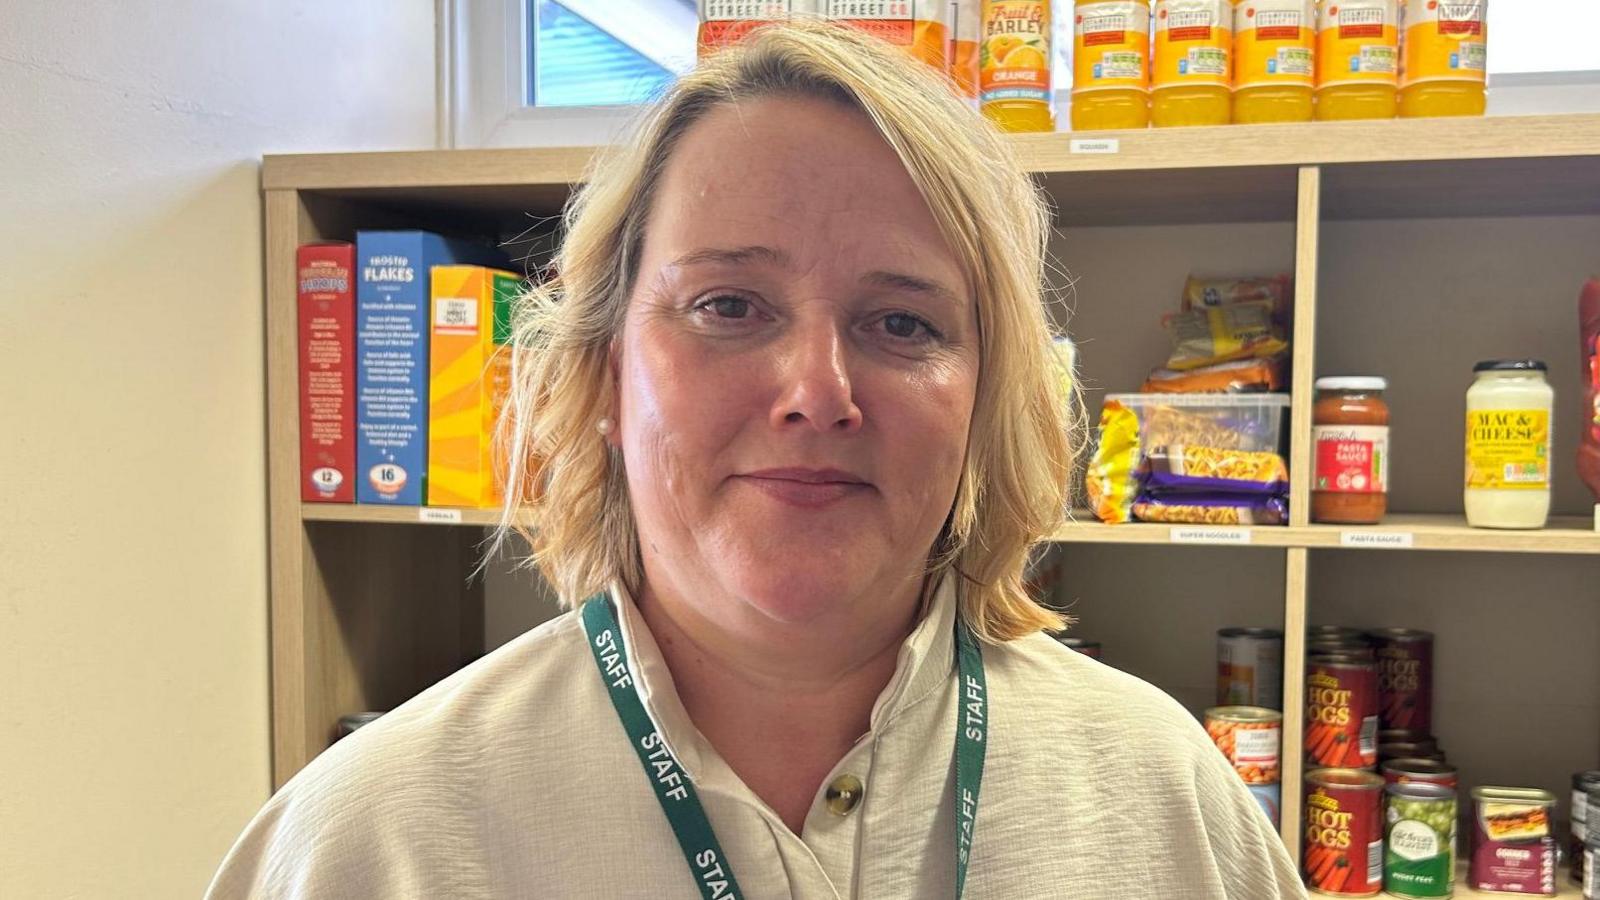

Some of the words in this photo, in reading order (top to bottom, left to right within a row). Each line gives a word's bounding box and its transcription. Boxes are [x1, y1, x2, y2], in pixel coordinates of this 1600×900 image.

[709, 4, 760, 17] STREET
[833, 3, 883, 16] STREET
[890, 3, 907, 16] CO
[992, 4, 1029, 20] Fruit
[987, 19, 1043, 36] BARLEY
[992, 70, 1038, 82] ORANGE
[364, 267, 415, 282] FLAKES
[1478, 413, 1513, 426] MAC
[1516, 413, 1532, 426] &
[1473, 428, 1533, 441] CHEESE
[1337, 443, 1367, 452] PASTA
[1336, 452, 1367, 462] SAUCE
[322, 471, 332, 482] 12
[381, 468, 394, 482] 16
[1205, 532, 1241, 540] NOODLES
[1350, 535, 1375, 543] PASTA
[1376, 535, 1402, 543] SAUCE
[595, 629, 632, 689] STAFF
[1378, 659, 1420, 674] HOT
[1309, 687, 1352, 706] HOT
[966, 675, 984, 742] STAFF
[641, 732, 688, 801] STAFF
[1309, 807, 1352, 829] HOT
[960, 788, 975, 864] STAFF
